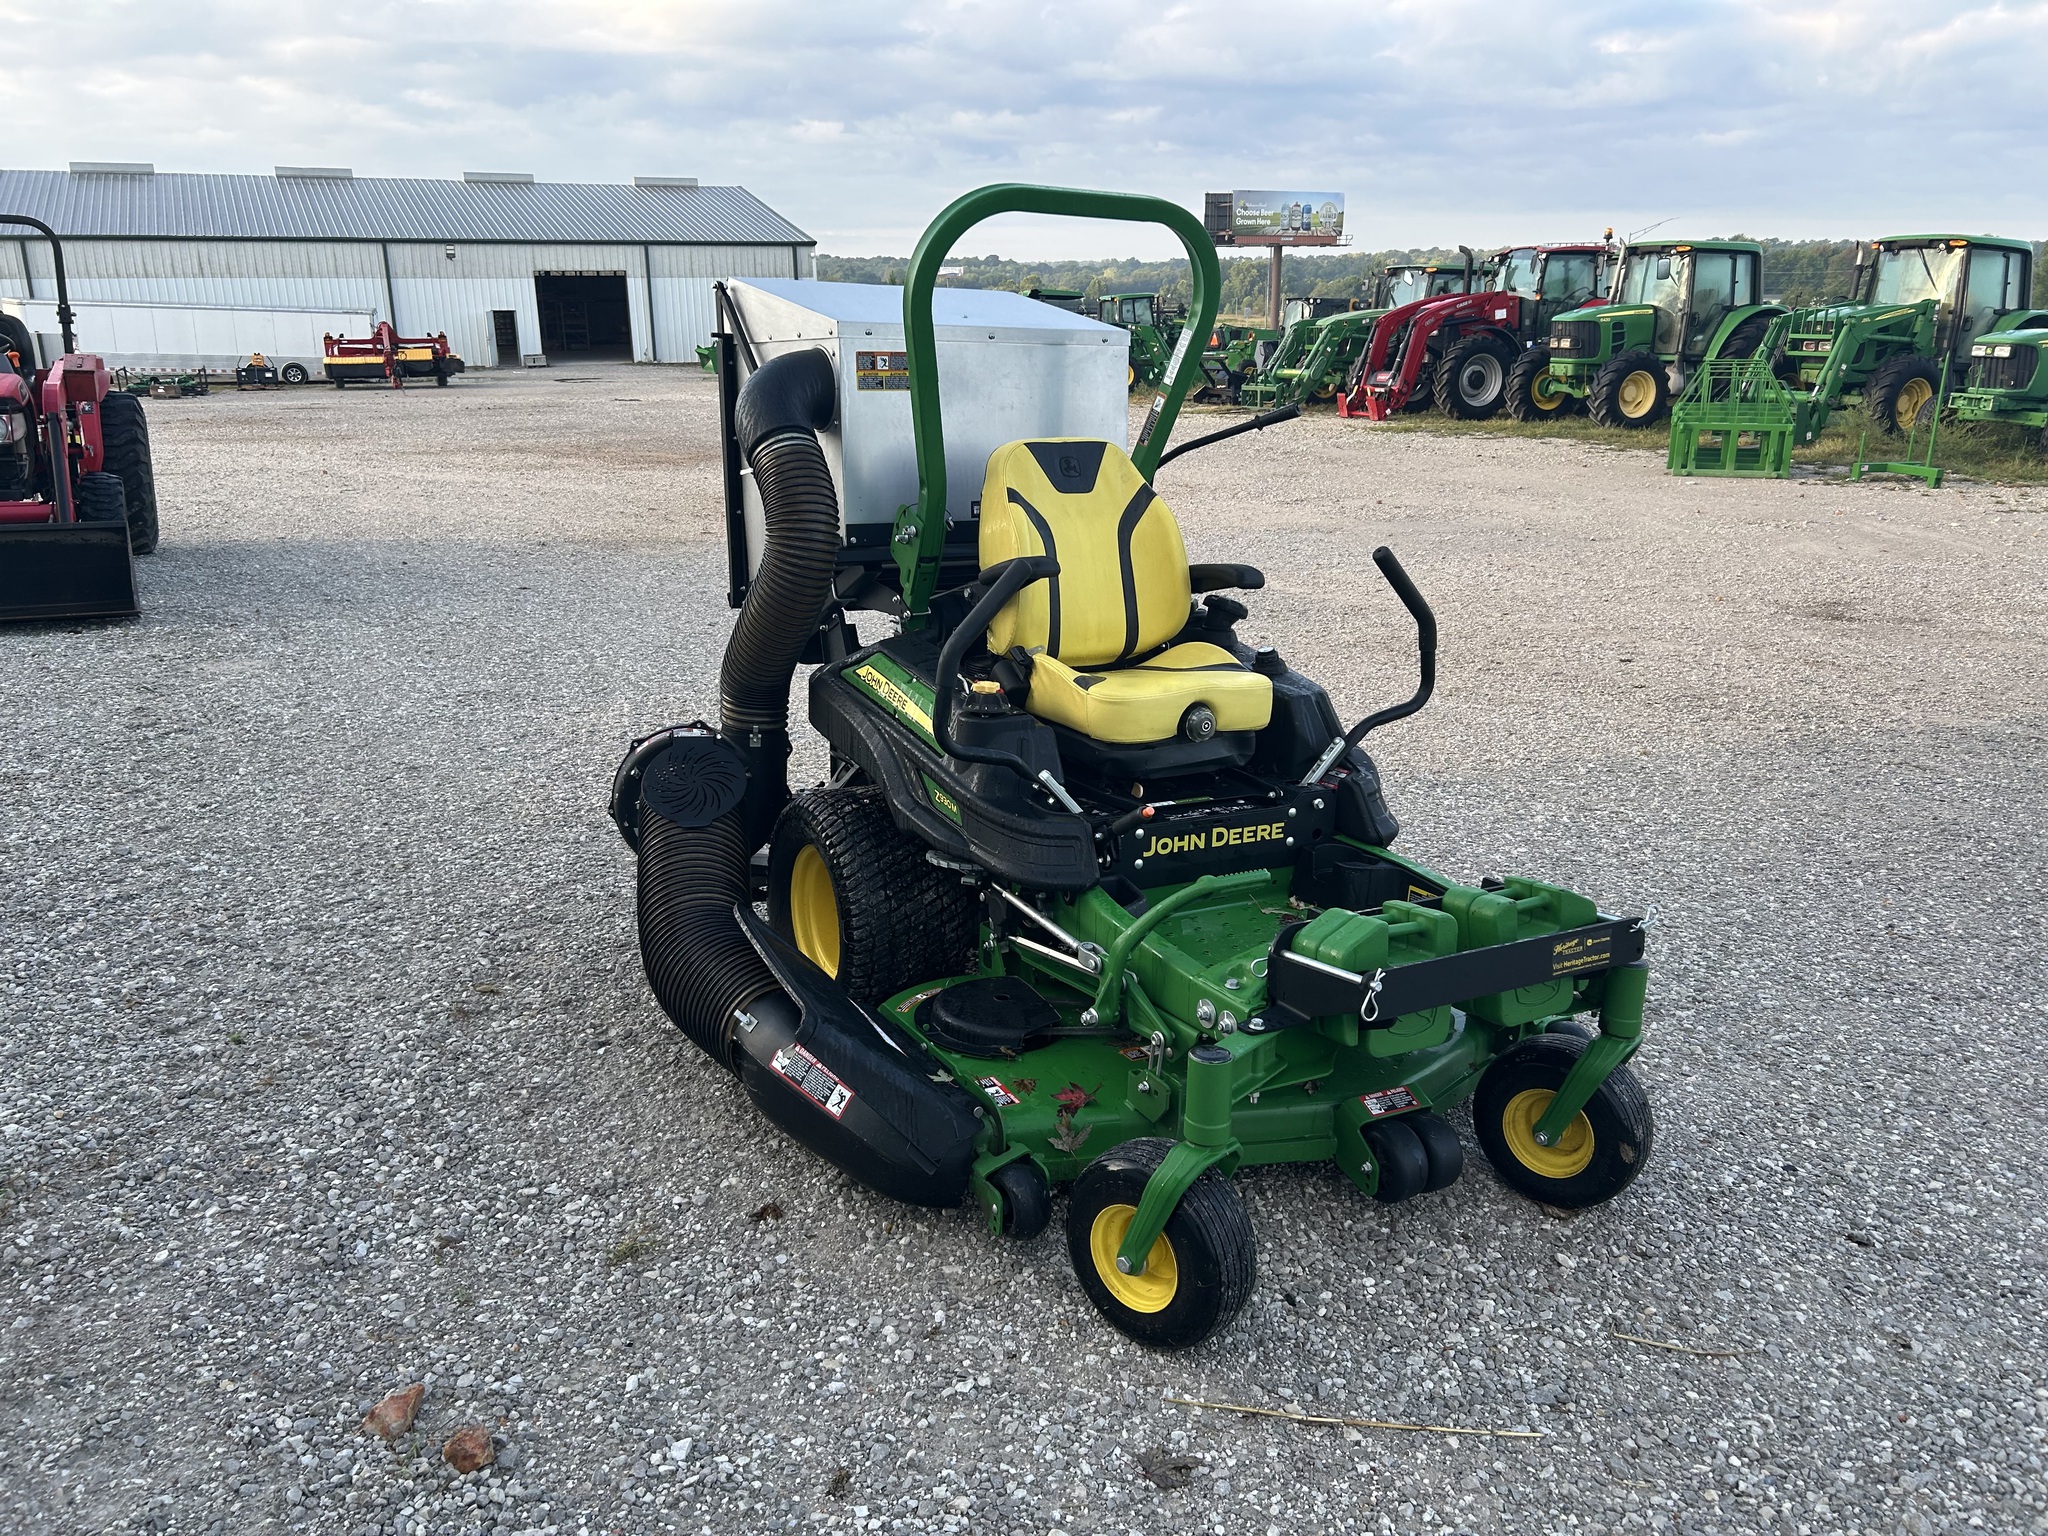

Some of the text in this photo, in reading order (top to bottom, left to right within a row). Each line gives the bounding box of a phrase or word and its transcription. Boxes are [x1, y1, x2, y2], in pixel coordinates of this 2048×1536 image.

[1236, 208, 1259, 216] Choose
[862, 668, 908, 711] JOHN DEERE
[934, 789, 958, 815] Z930M
[1142, 822, 1285, 858] JOHN DEERE
[1553, 938, 1579, 955] Heritage
[1564, 952, 1610, 967] HeritageTractor.com
[800, 1047, 816, 1063] DANGER
